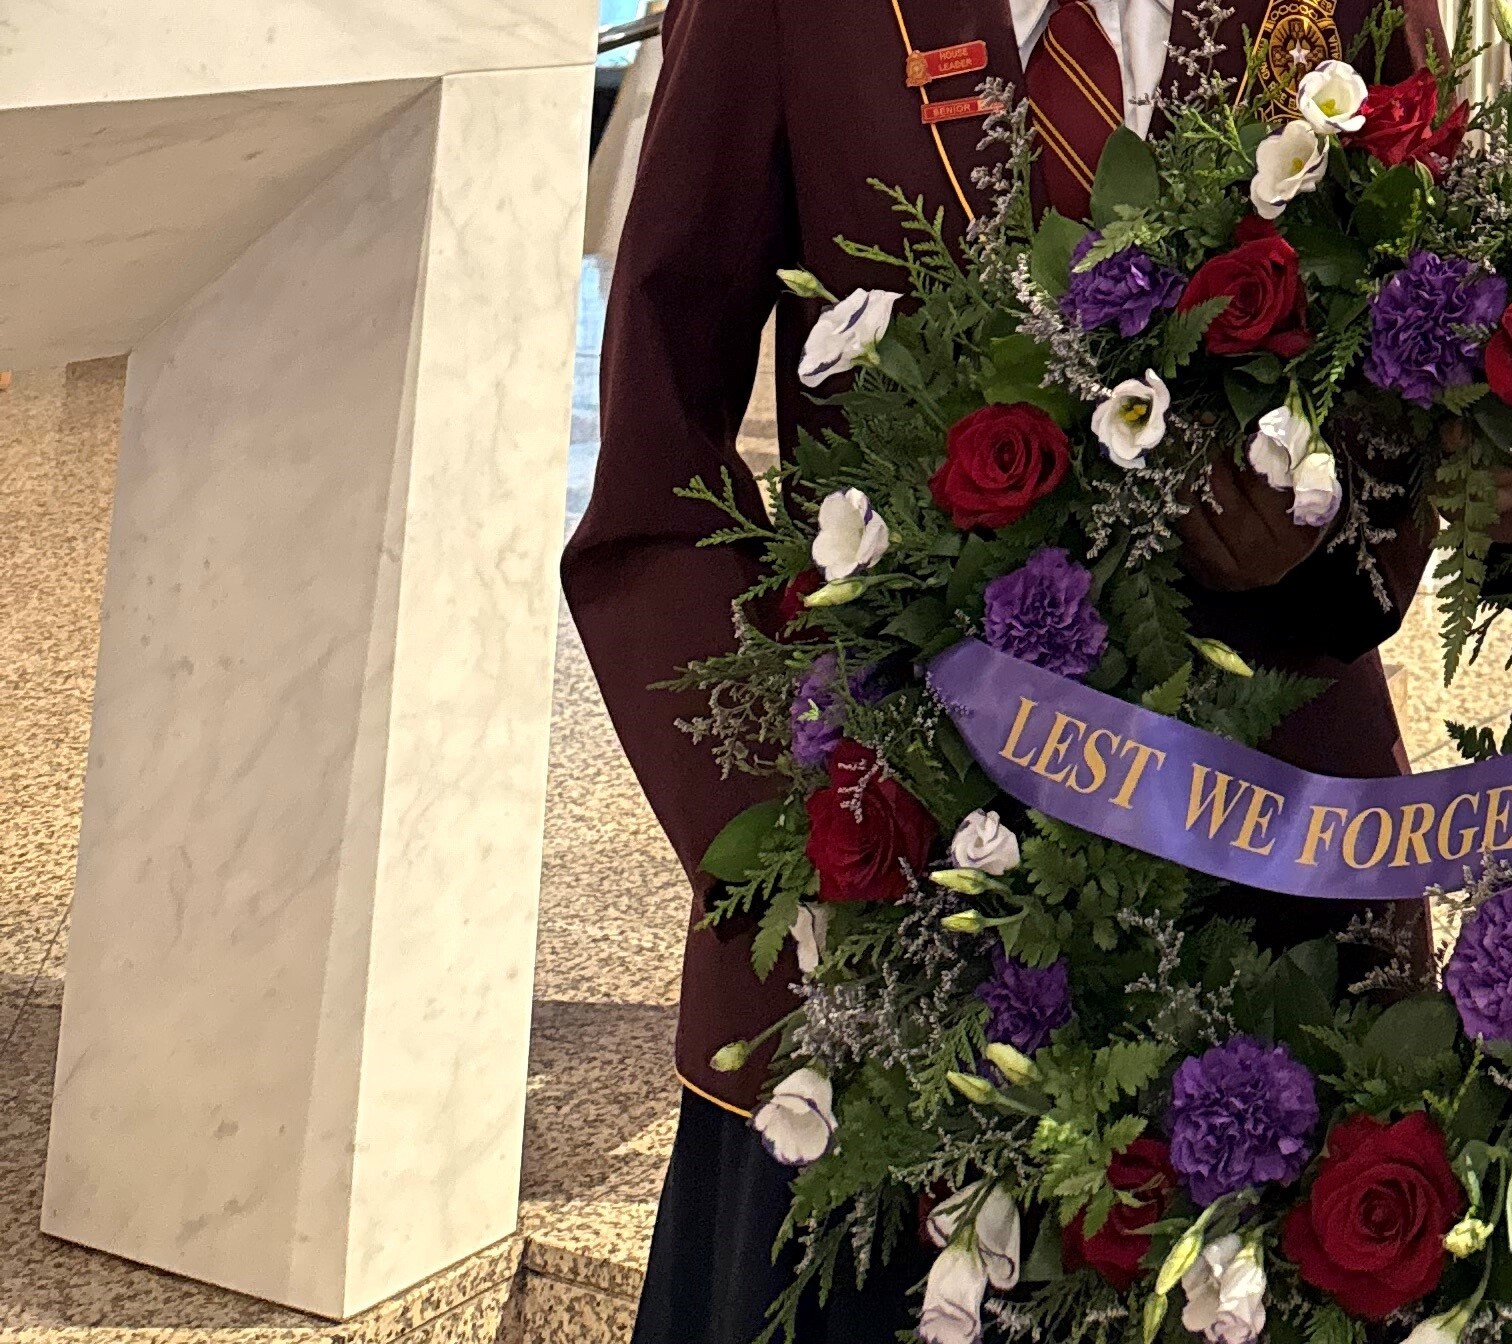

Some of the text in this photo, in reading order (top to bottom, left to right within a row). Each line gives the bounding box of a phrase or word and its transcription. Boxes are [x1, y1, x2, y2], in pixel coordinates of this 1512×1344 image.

[940, 47, 968, 61] HOUSE
[939, 58, 972, 71] LEADER
[933, 104, 971, 116] SENIOR
[999, 696, 1166, 809] LEST
[1185, 763, 1285, 855] WE
